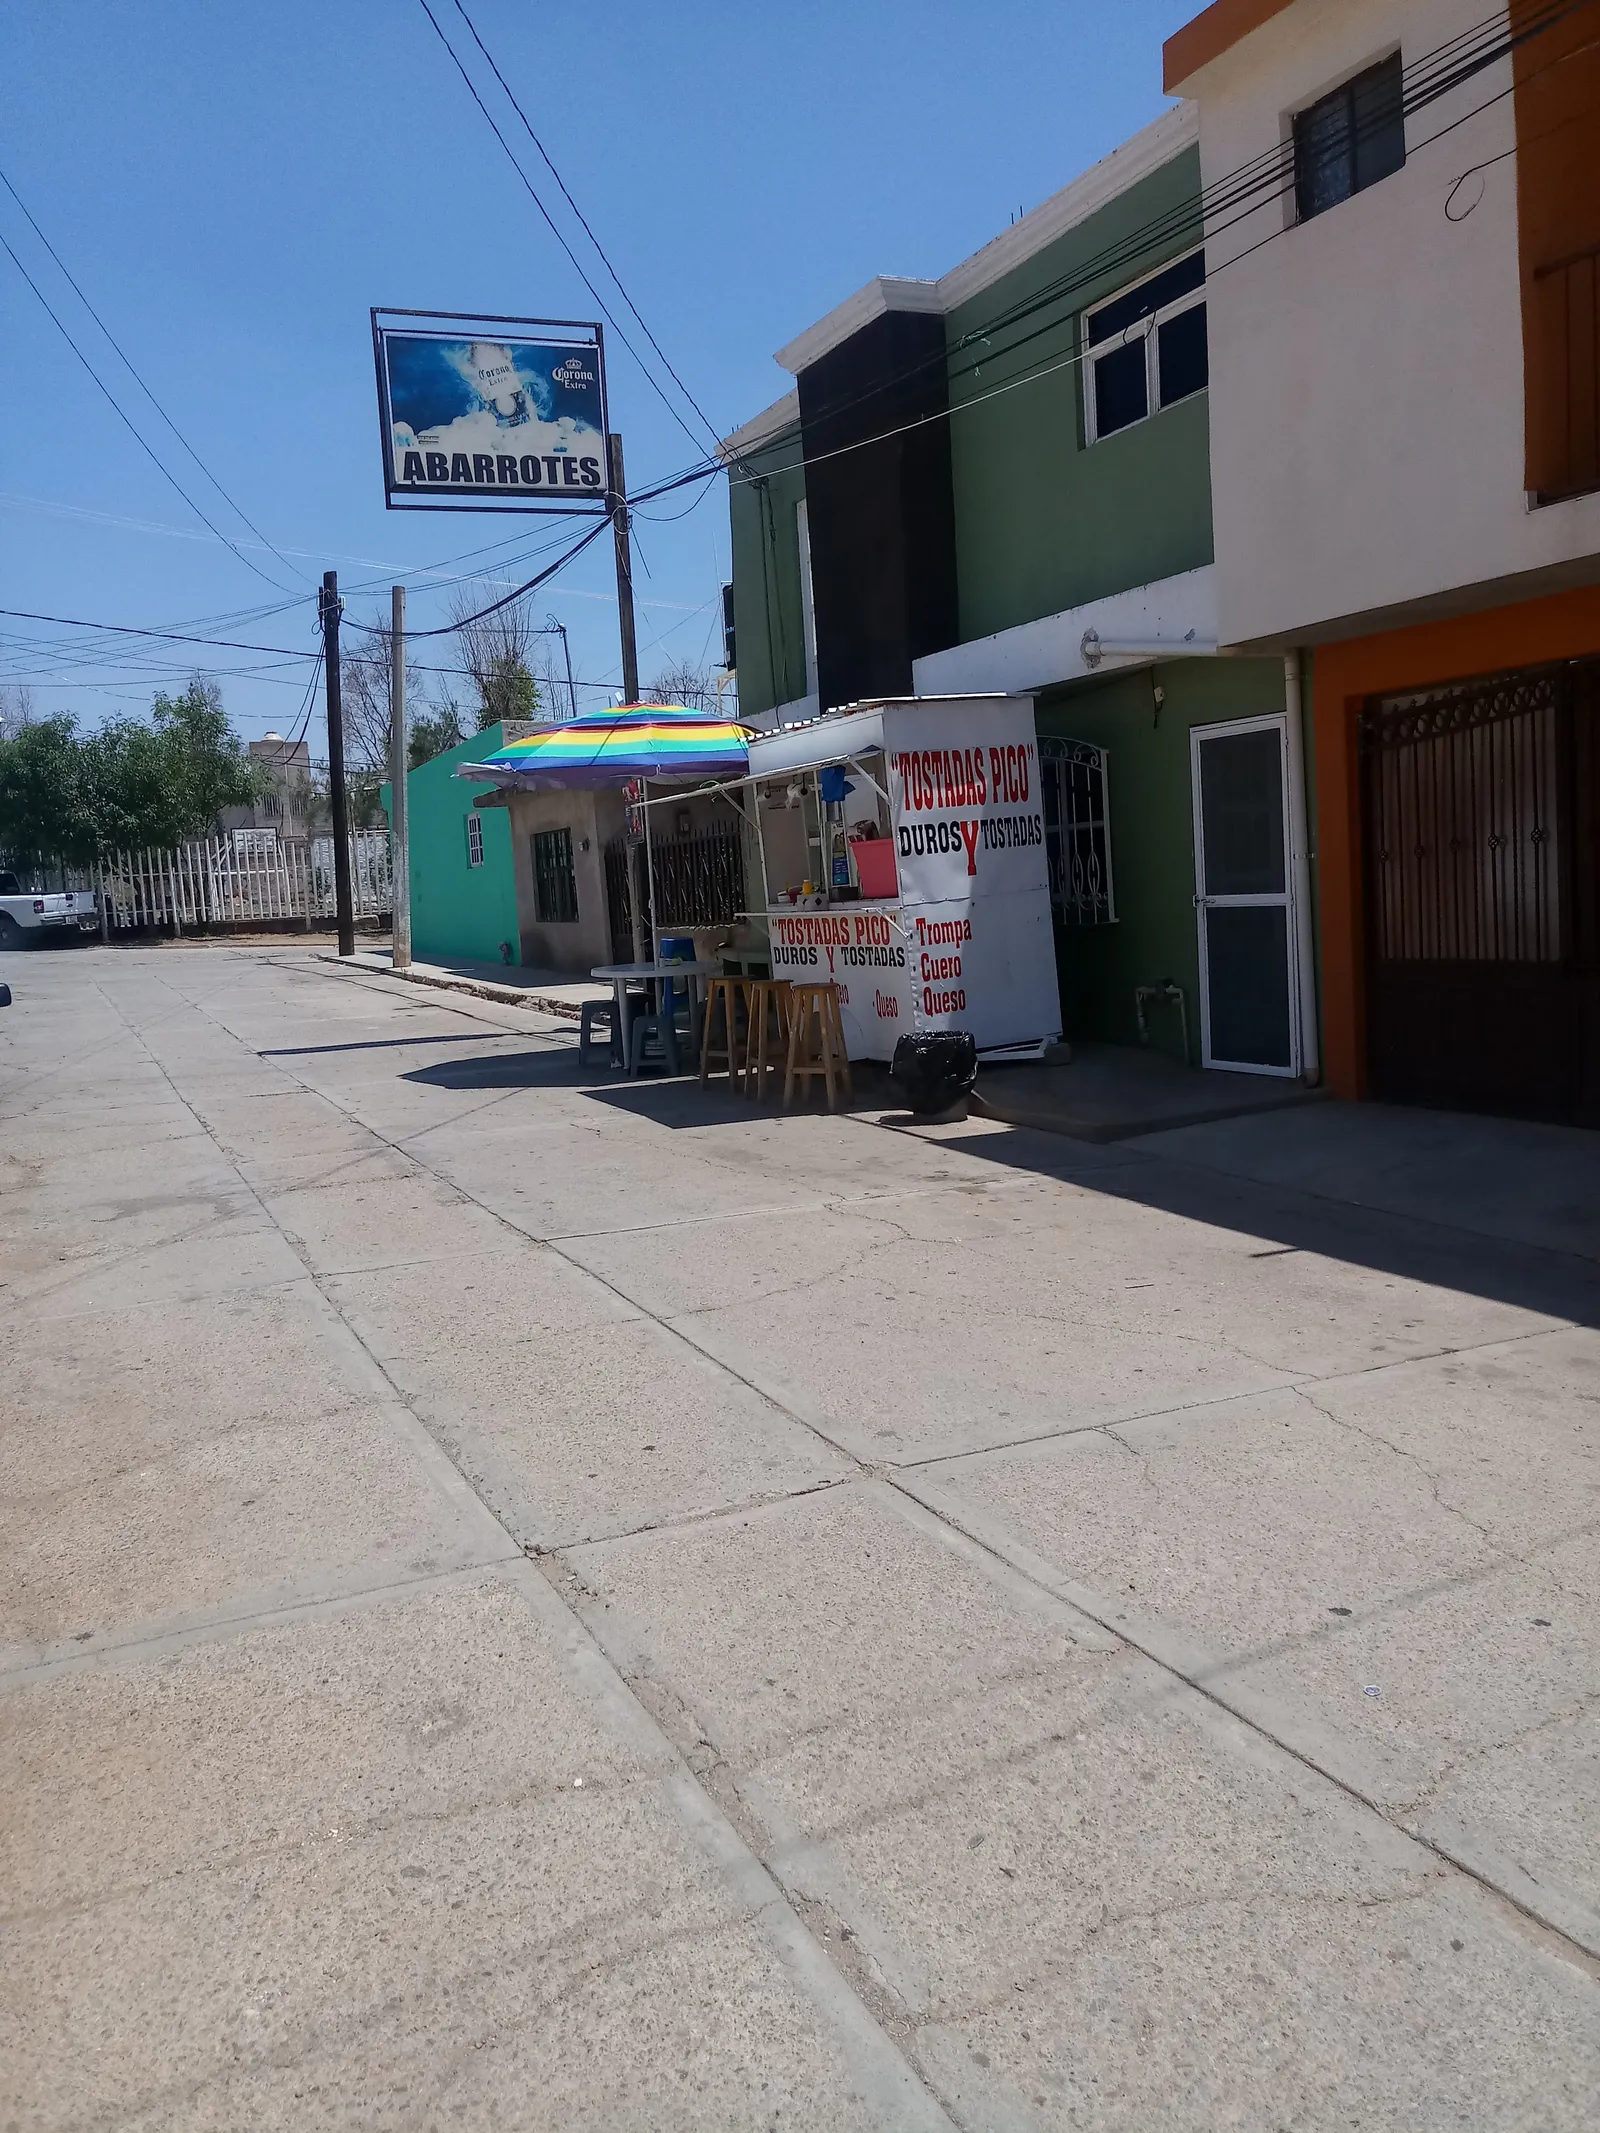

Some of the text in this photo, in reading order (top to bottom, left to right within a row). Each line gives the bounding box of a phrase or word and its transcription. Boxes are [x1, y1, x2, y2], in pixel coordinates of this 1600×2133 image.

[552, 367, 594, 382] Corona
[564, 380, 587, 390] Extra
[403, 451, 601, 487] ABARROTES
[891, 744, 1033, 811] "TOSTADAS PICO"
[898, 814, 1042, 876] DUROS Y TOSTADAS
[772, 917, 850, 946] "TOSTADAS
[916, 917, 972, 949] Trompa
[773, 946, 905, 973] DUROS Y TOSTADAS
[920, 953, 962, 982] Cuero
[876, 989, 898, 1018] Queso
[923, 986, 966, 1017] Queso
